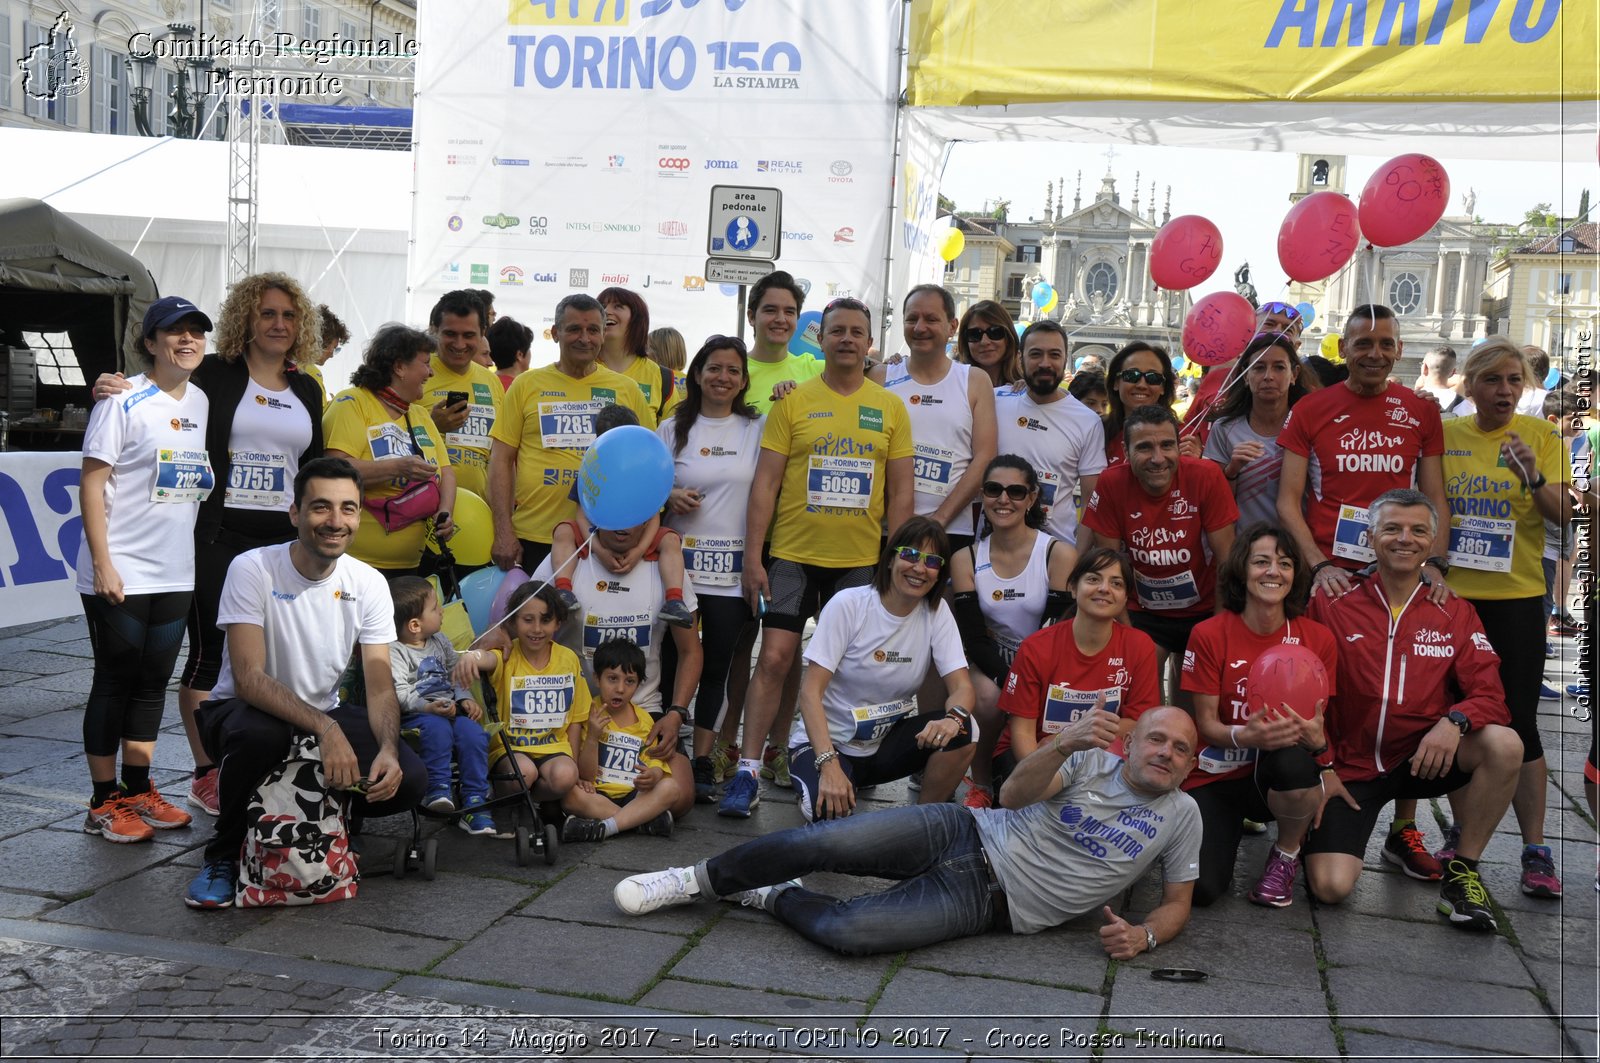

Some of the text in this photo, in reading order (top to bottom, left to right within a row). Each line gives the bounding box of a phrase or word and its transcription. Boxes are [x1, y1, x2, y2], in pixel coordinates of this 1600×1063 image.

[507, 34, 801, 91] TORINO 150
[713, 76, 800, 90] LA STAMPA
[659, 157, 690, 171] coop
[734, 192, 756, 201] area
[722, 202, 767, 212] pedonale
[530, 216, 548, 227] GO
[534, 273, 557, 283] Cuki
[601, 273, 629, 284] inalpi
[1386, 396, 1402, 405] PACER
[554, 415, 593, 434] 7285
[860, 415, 882, 423] Arredo3
[913, 458, 941, 480] 315
[1336, 453, 1404, 473] TORINO
[175, 471, 202, 489] 2182
[231, 465, 274, 490] 6755
[821, 475, 860, 494] 5099
[1447, 498, 1511, 519] TORINO
[1457, 537, 1492, 555] 3867
[693, 551, 734, 573] 8539
[1129, 547, 1191, 566] TORINO
[1151, 590, 1176, 600] 615
[1413, 644, 1454, 657] TORINO
[525, 690, 566, 713] 6330
[1224, 749, 1248, 761] 617
[1116, 811, 1157, 839] TORINO
[1079, 816, 1144, 859] MOTIVATOR
